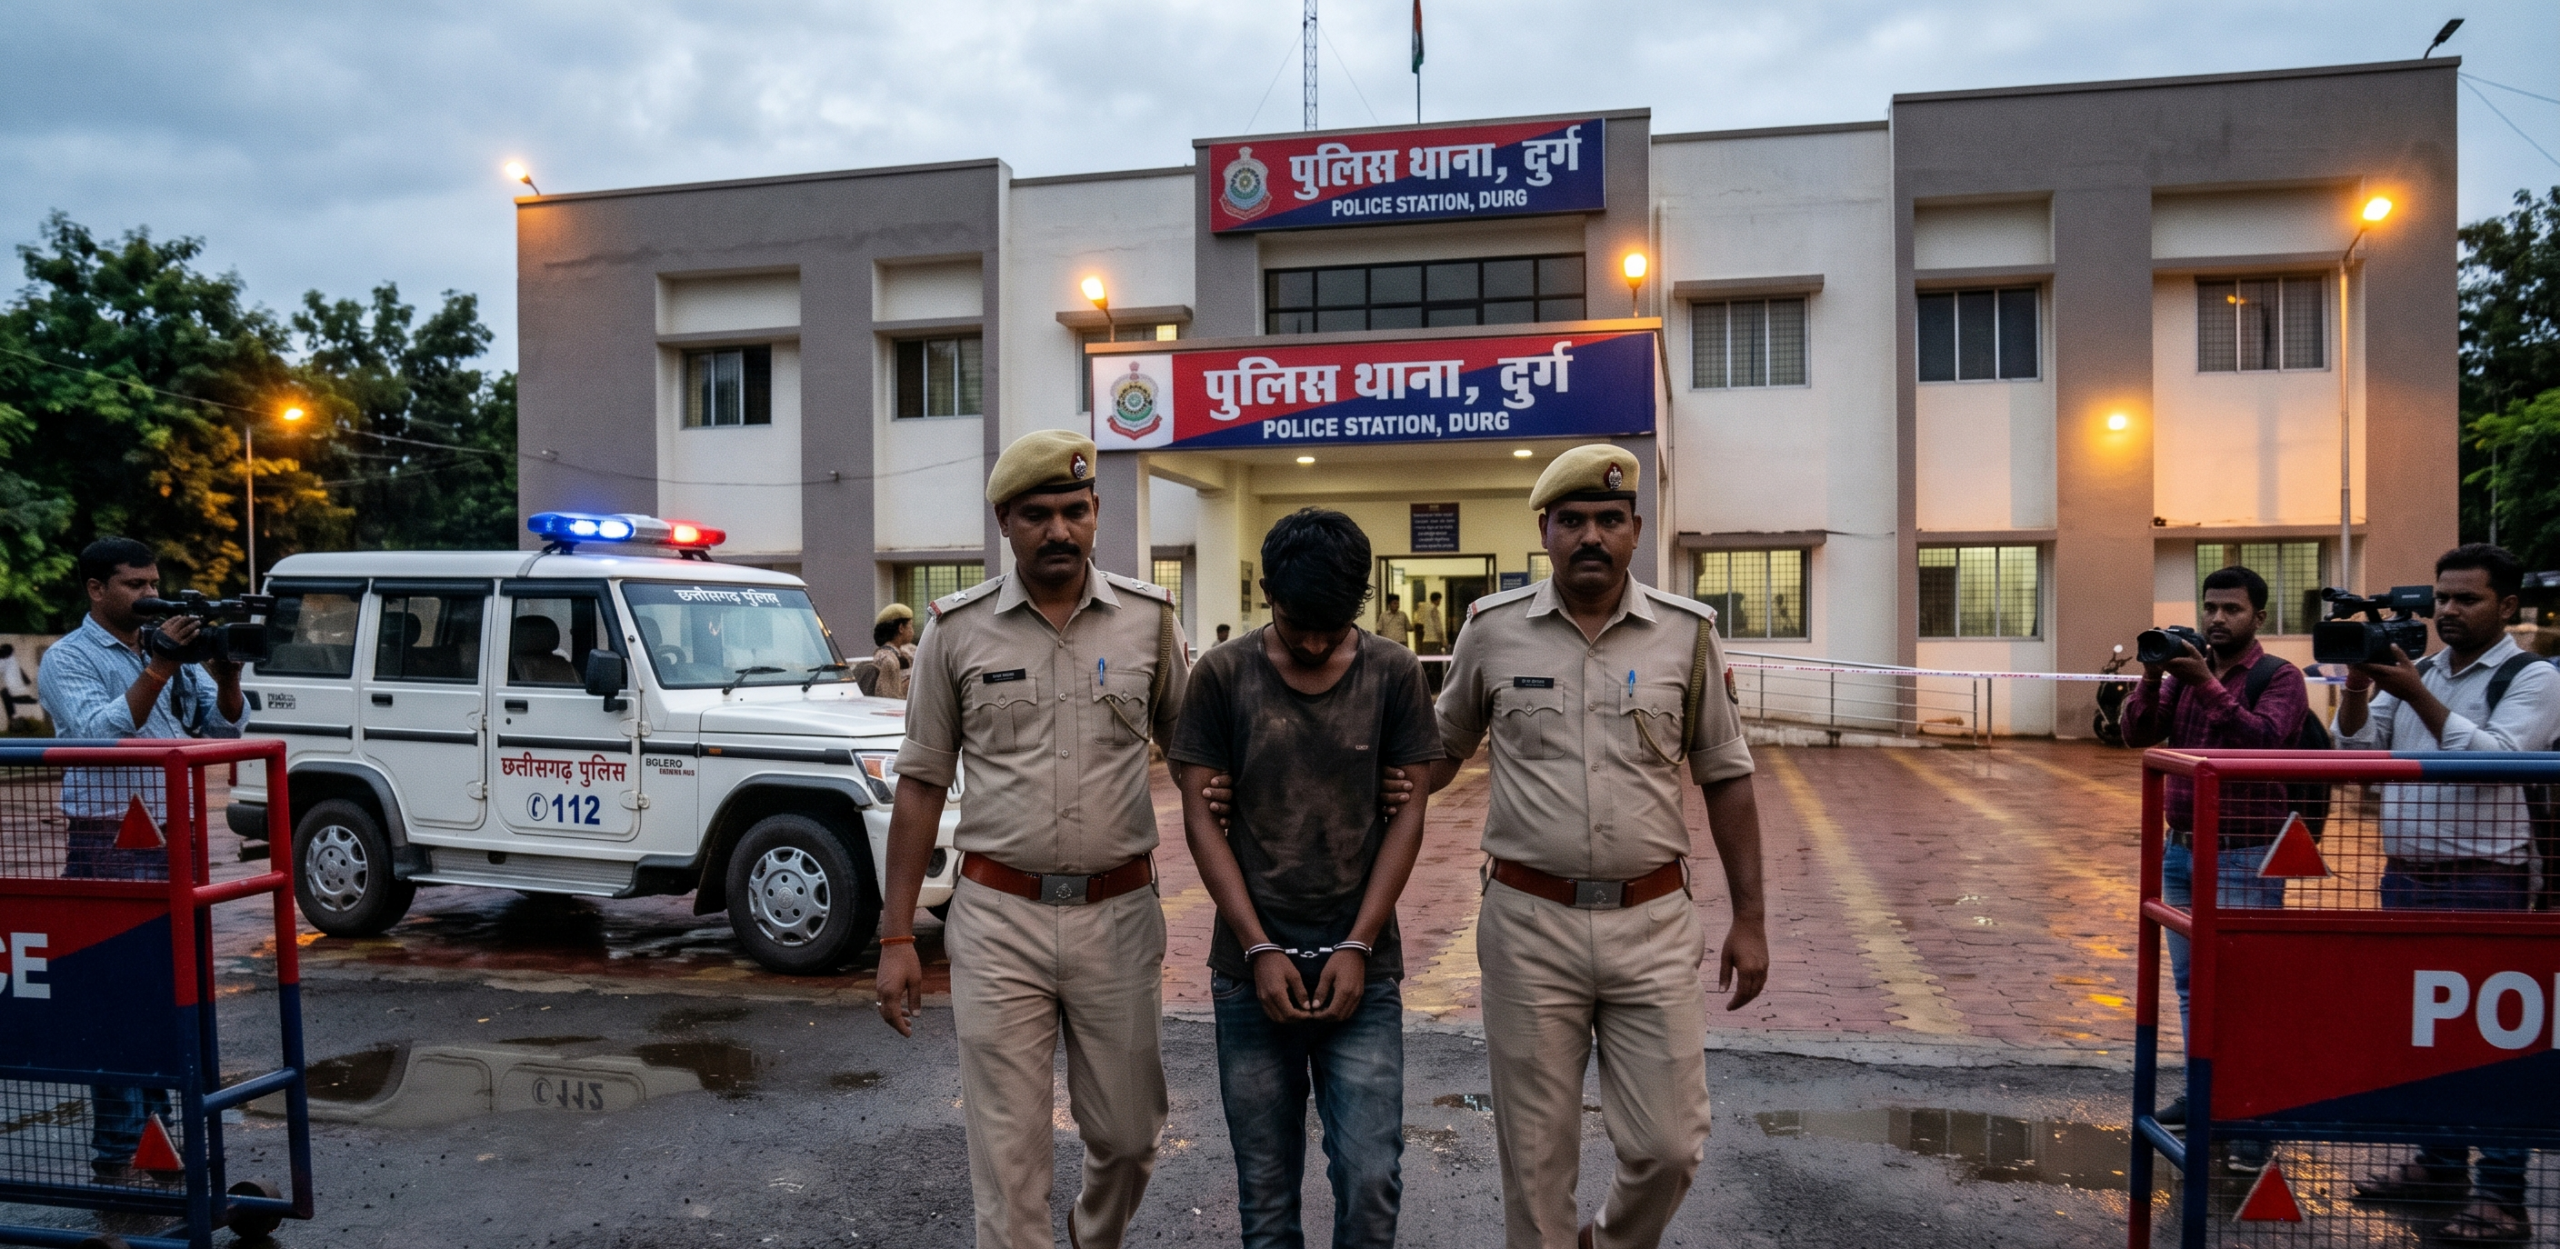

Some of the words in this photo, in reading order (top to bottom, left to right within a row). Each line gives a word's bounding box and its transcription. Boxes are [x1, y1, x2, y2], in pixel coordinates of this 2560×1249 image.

[1289, 142, 1399, 200] पुलिस
[1409, 142, 1508, 183] थाना,
[1522, 124, 1582, 187] दुर्ग
[1331, 196, 1392, 217] POLICE
[1396, 192, 1475, 213] STATION,
[1479, 188, 1528, 208] DURG
[1203, 356, 1341, 421] पुलिस
[1354, 359, 1480, 405] थाना,
[1497, 341, 1574, 410] दुर्ग
[1263, 418, 1338, 439] POLICE
[1344, 415, 1442, 437] STATION,
[1449, 411, 1510, 432] DURG
[578, 754, 627, 787] पुलिस
[552, 793, 600, 825] 112
[0, 932, 51, 999] E
[2411, 970, 2560, 1050] PO
